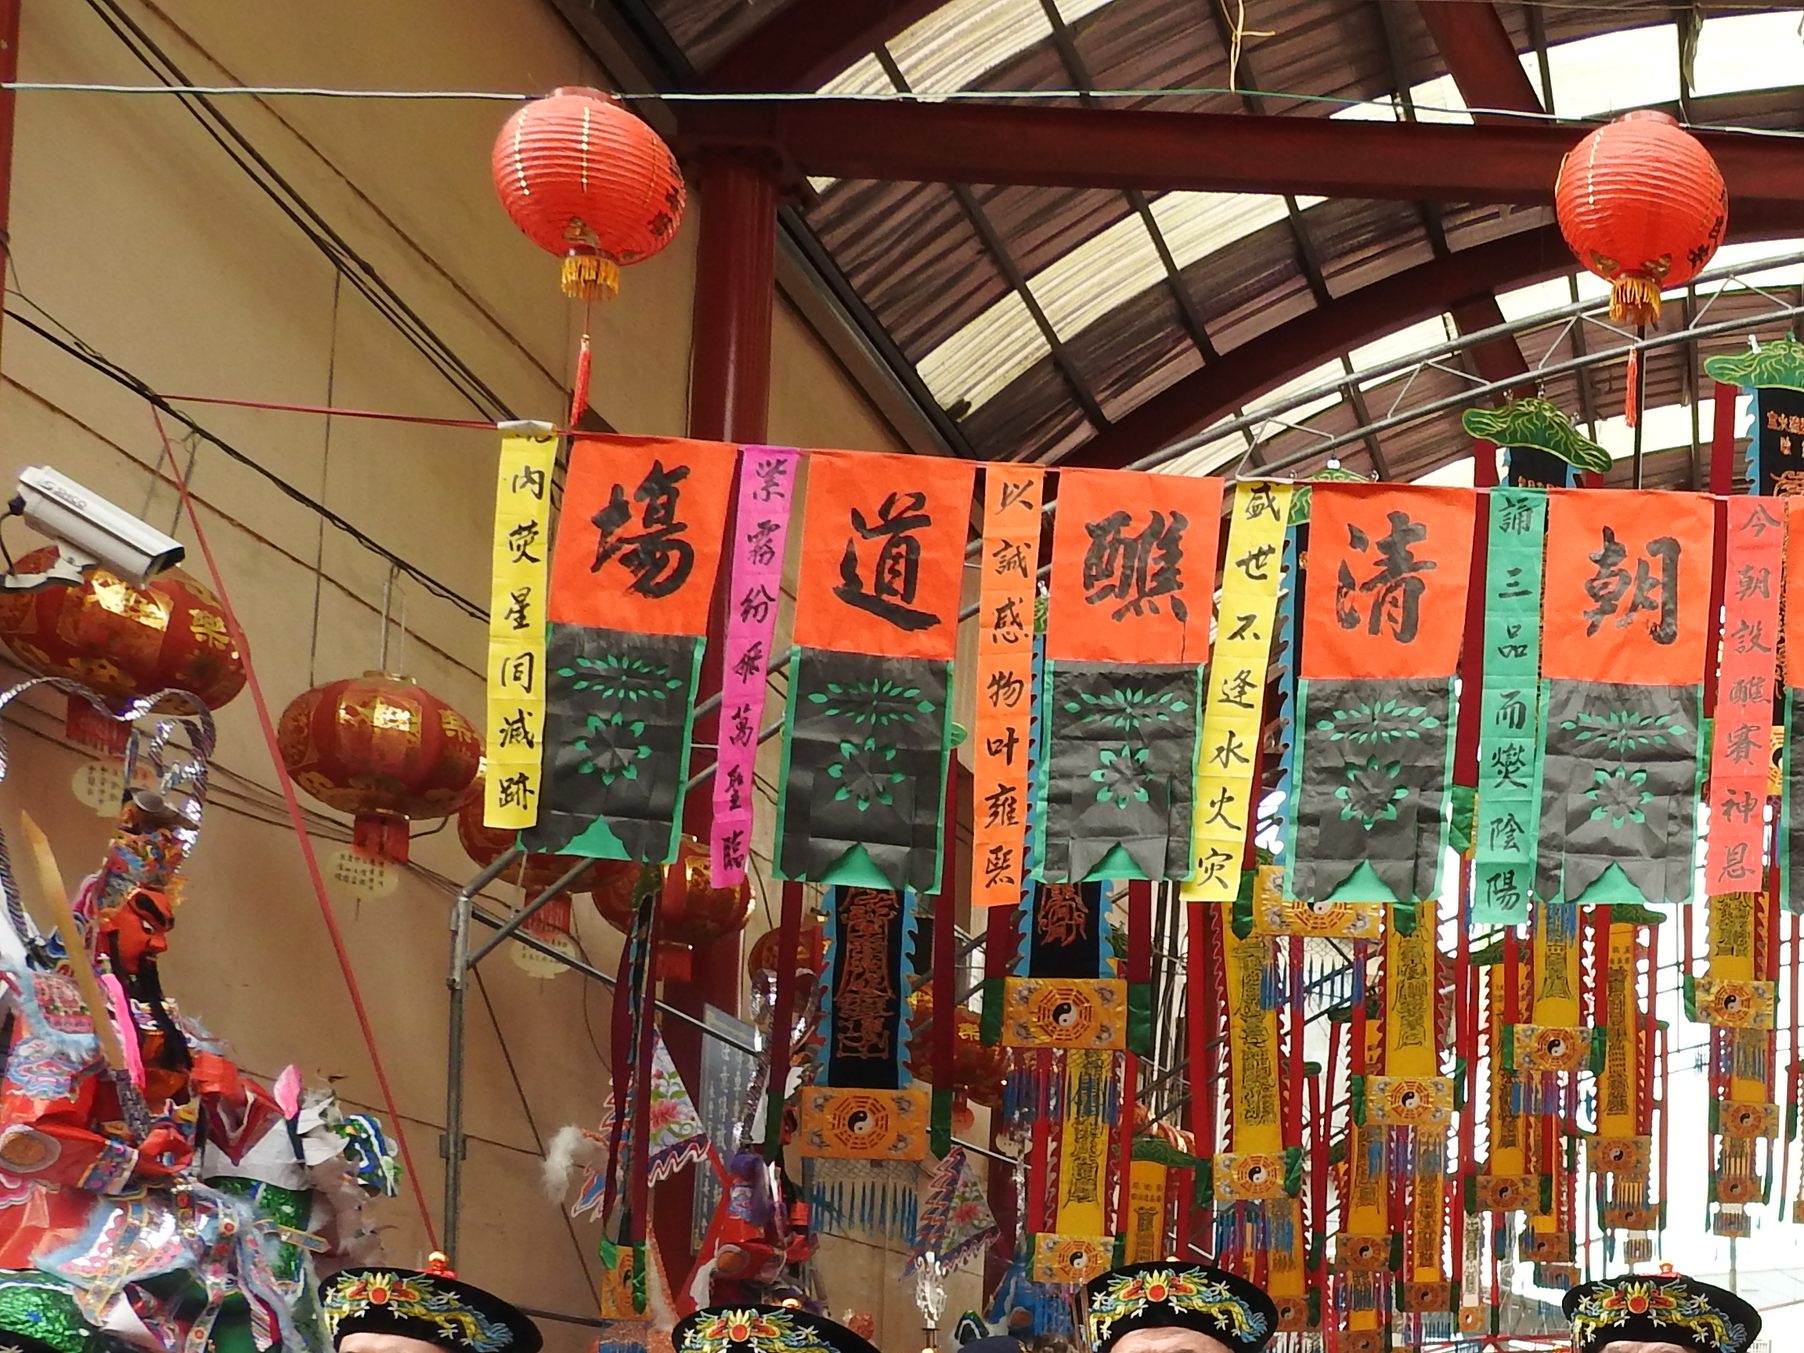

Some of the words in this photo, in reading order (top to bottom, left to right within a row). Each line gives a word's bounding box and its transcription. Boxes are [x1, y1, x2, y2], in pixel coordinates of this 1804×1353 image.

[590, 459, 695, 599] 場
[833, 491, 942, 632] 道
[1083, 509, 1189, 624] 醮
[1336, 511, 1437, 643] 清
[1583, 526, 1682, 645] 朝
[1716, 503, 1782, 884] 今朝設醮賽神恩
